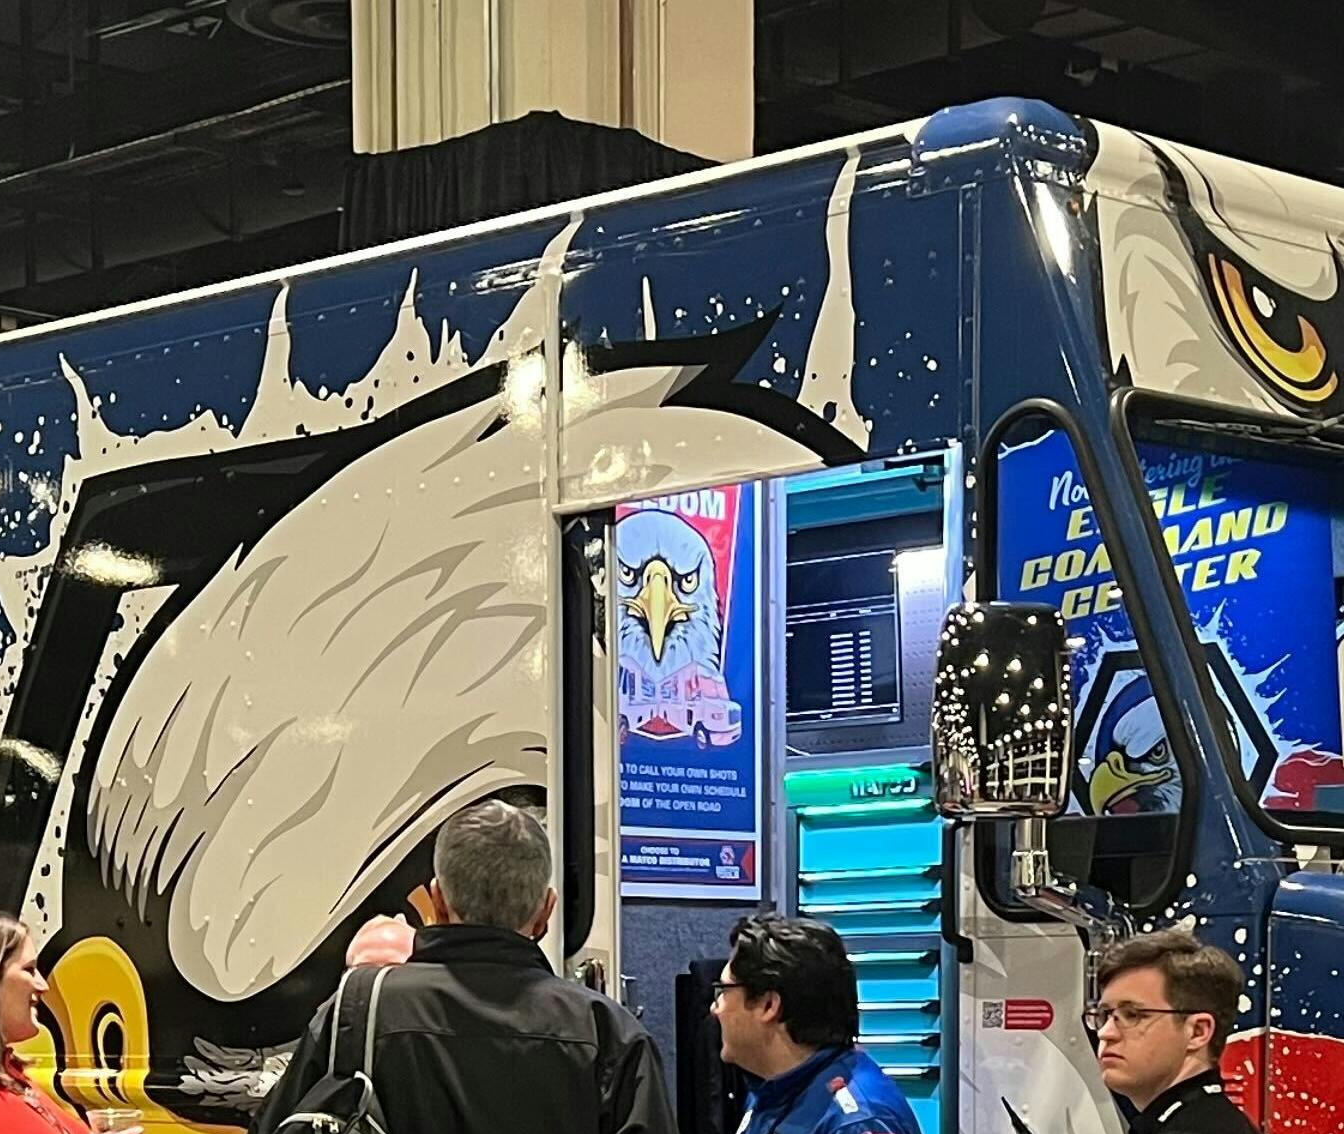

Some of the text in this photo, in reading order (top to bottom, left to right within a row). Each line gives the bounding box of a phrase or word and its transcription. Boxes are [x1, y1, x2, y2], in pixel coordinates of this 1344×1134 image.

[661, 766, 685, 777] YOUR
[656, 783, 679, 793] YOUR
[655, 799, 671, 810] THE
